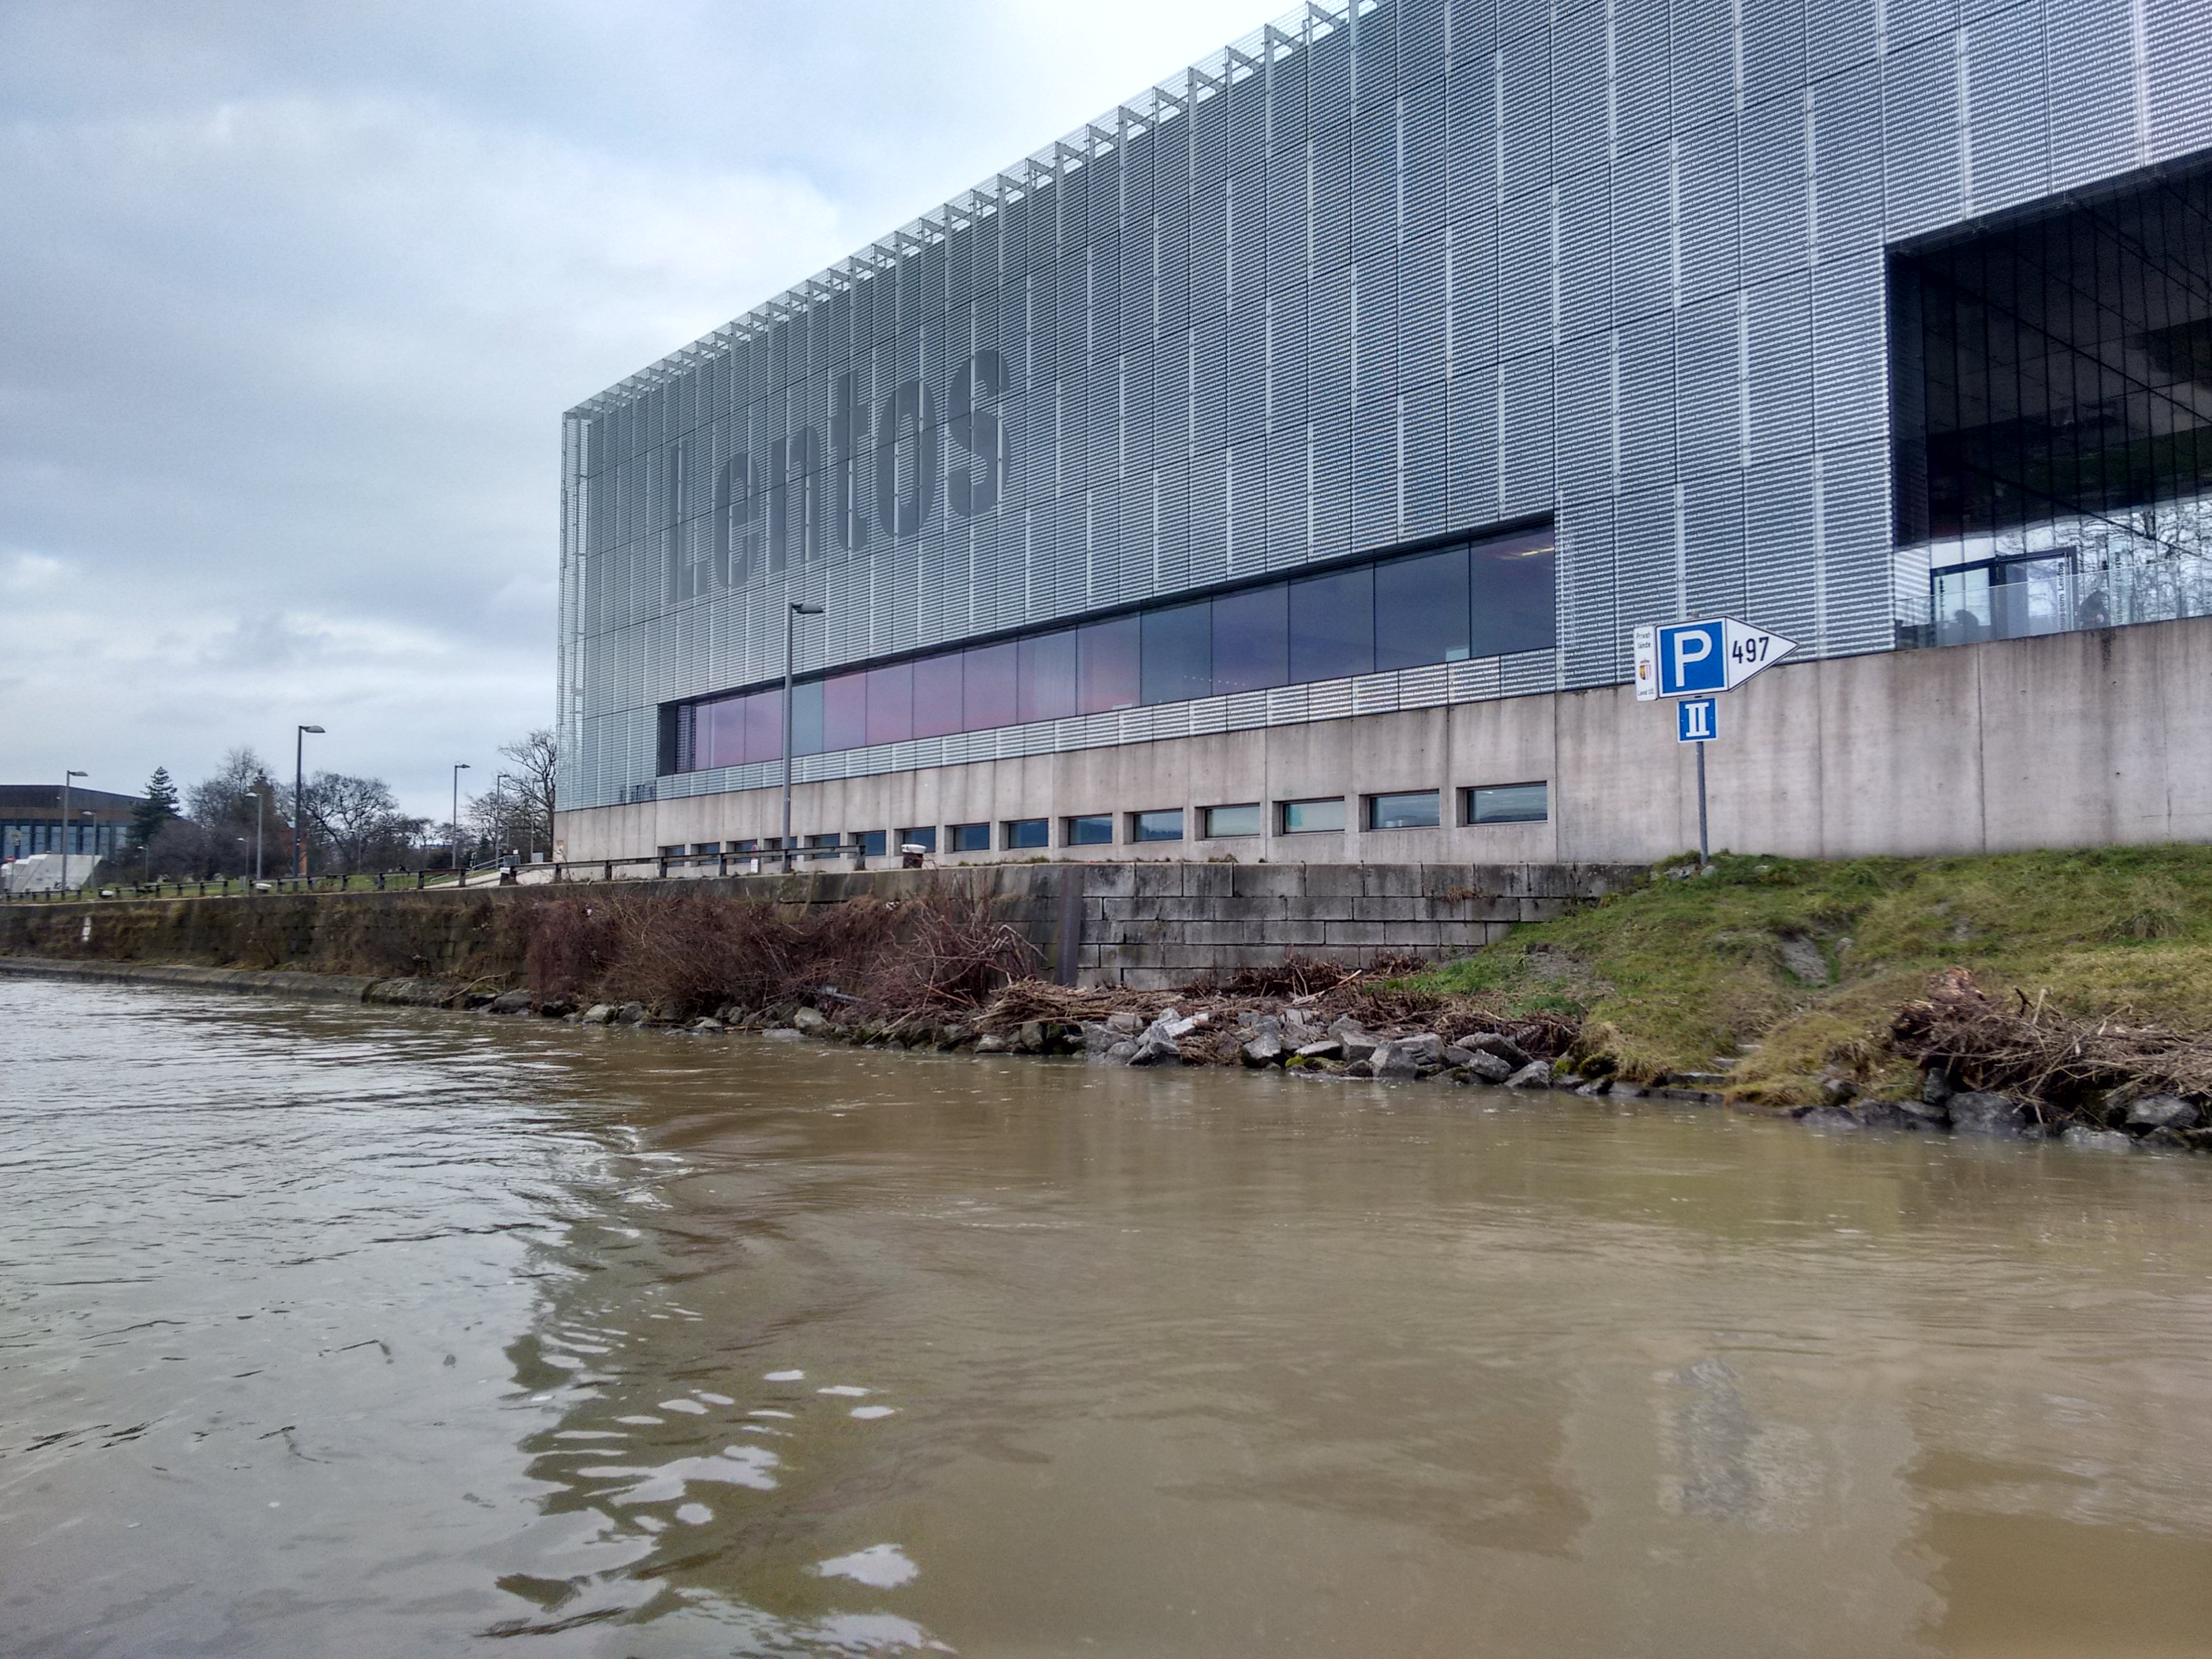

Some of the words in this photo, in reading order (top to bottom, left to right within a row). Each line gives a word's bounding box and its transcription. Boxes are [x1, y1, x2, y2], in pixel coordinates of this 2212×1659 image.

[670, 350, 1012, 605] Lentos
[1674, 630, 1712, 687] P
[1732, 636, 1769, 664] 497
